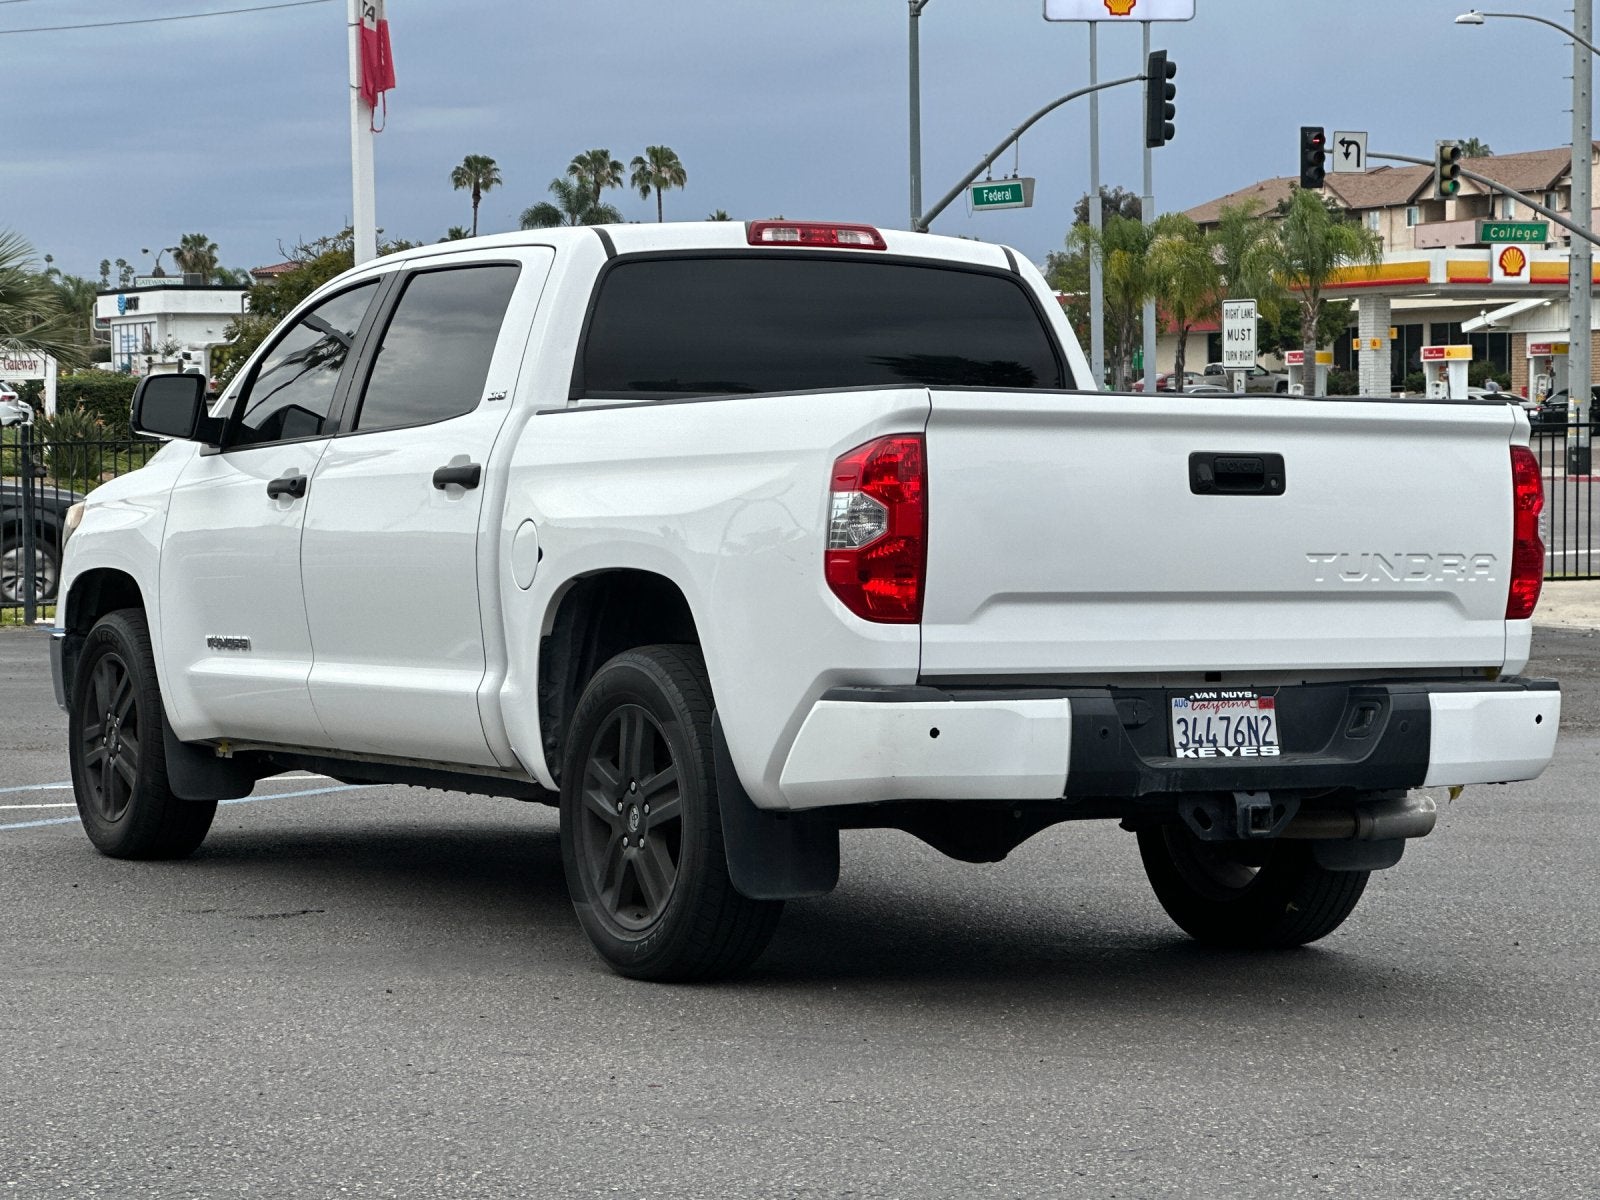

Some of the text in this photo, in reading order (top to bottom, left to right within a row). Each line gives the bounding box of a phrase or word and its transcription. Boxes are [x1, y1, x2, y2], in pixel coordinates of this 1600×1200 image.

[983, 188, 1012, 202] Federal
[1490, 227, 1538, 240] College
[1225, 308, 1254, 319] RIGHT LANE
[1227, 328, 1251, 341] MUST
[1225, 350, 1254, 361] TURN RIGHT
[4, 357, 38, 374] Gateway
[1306, 553, 1497, 582] TUNDRA
[1221, 691, 1252, 699] NUYS
[1174, 699, 1189, 708] AUG
[1191, 700, 1257, 714] California
[1177, 715, 1274, 747] 34476N2
[1176, 746, 1280, 758] KEYES
